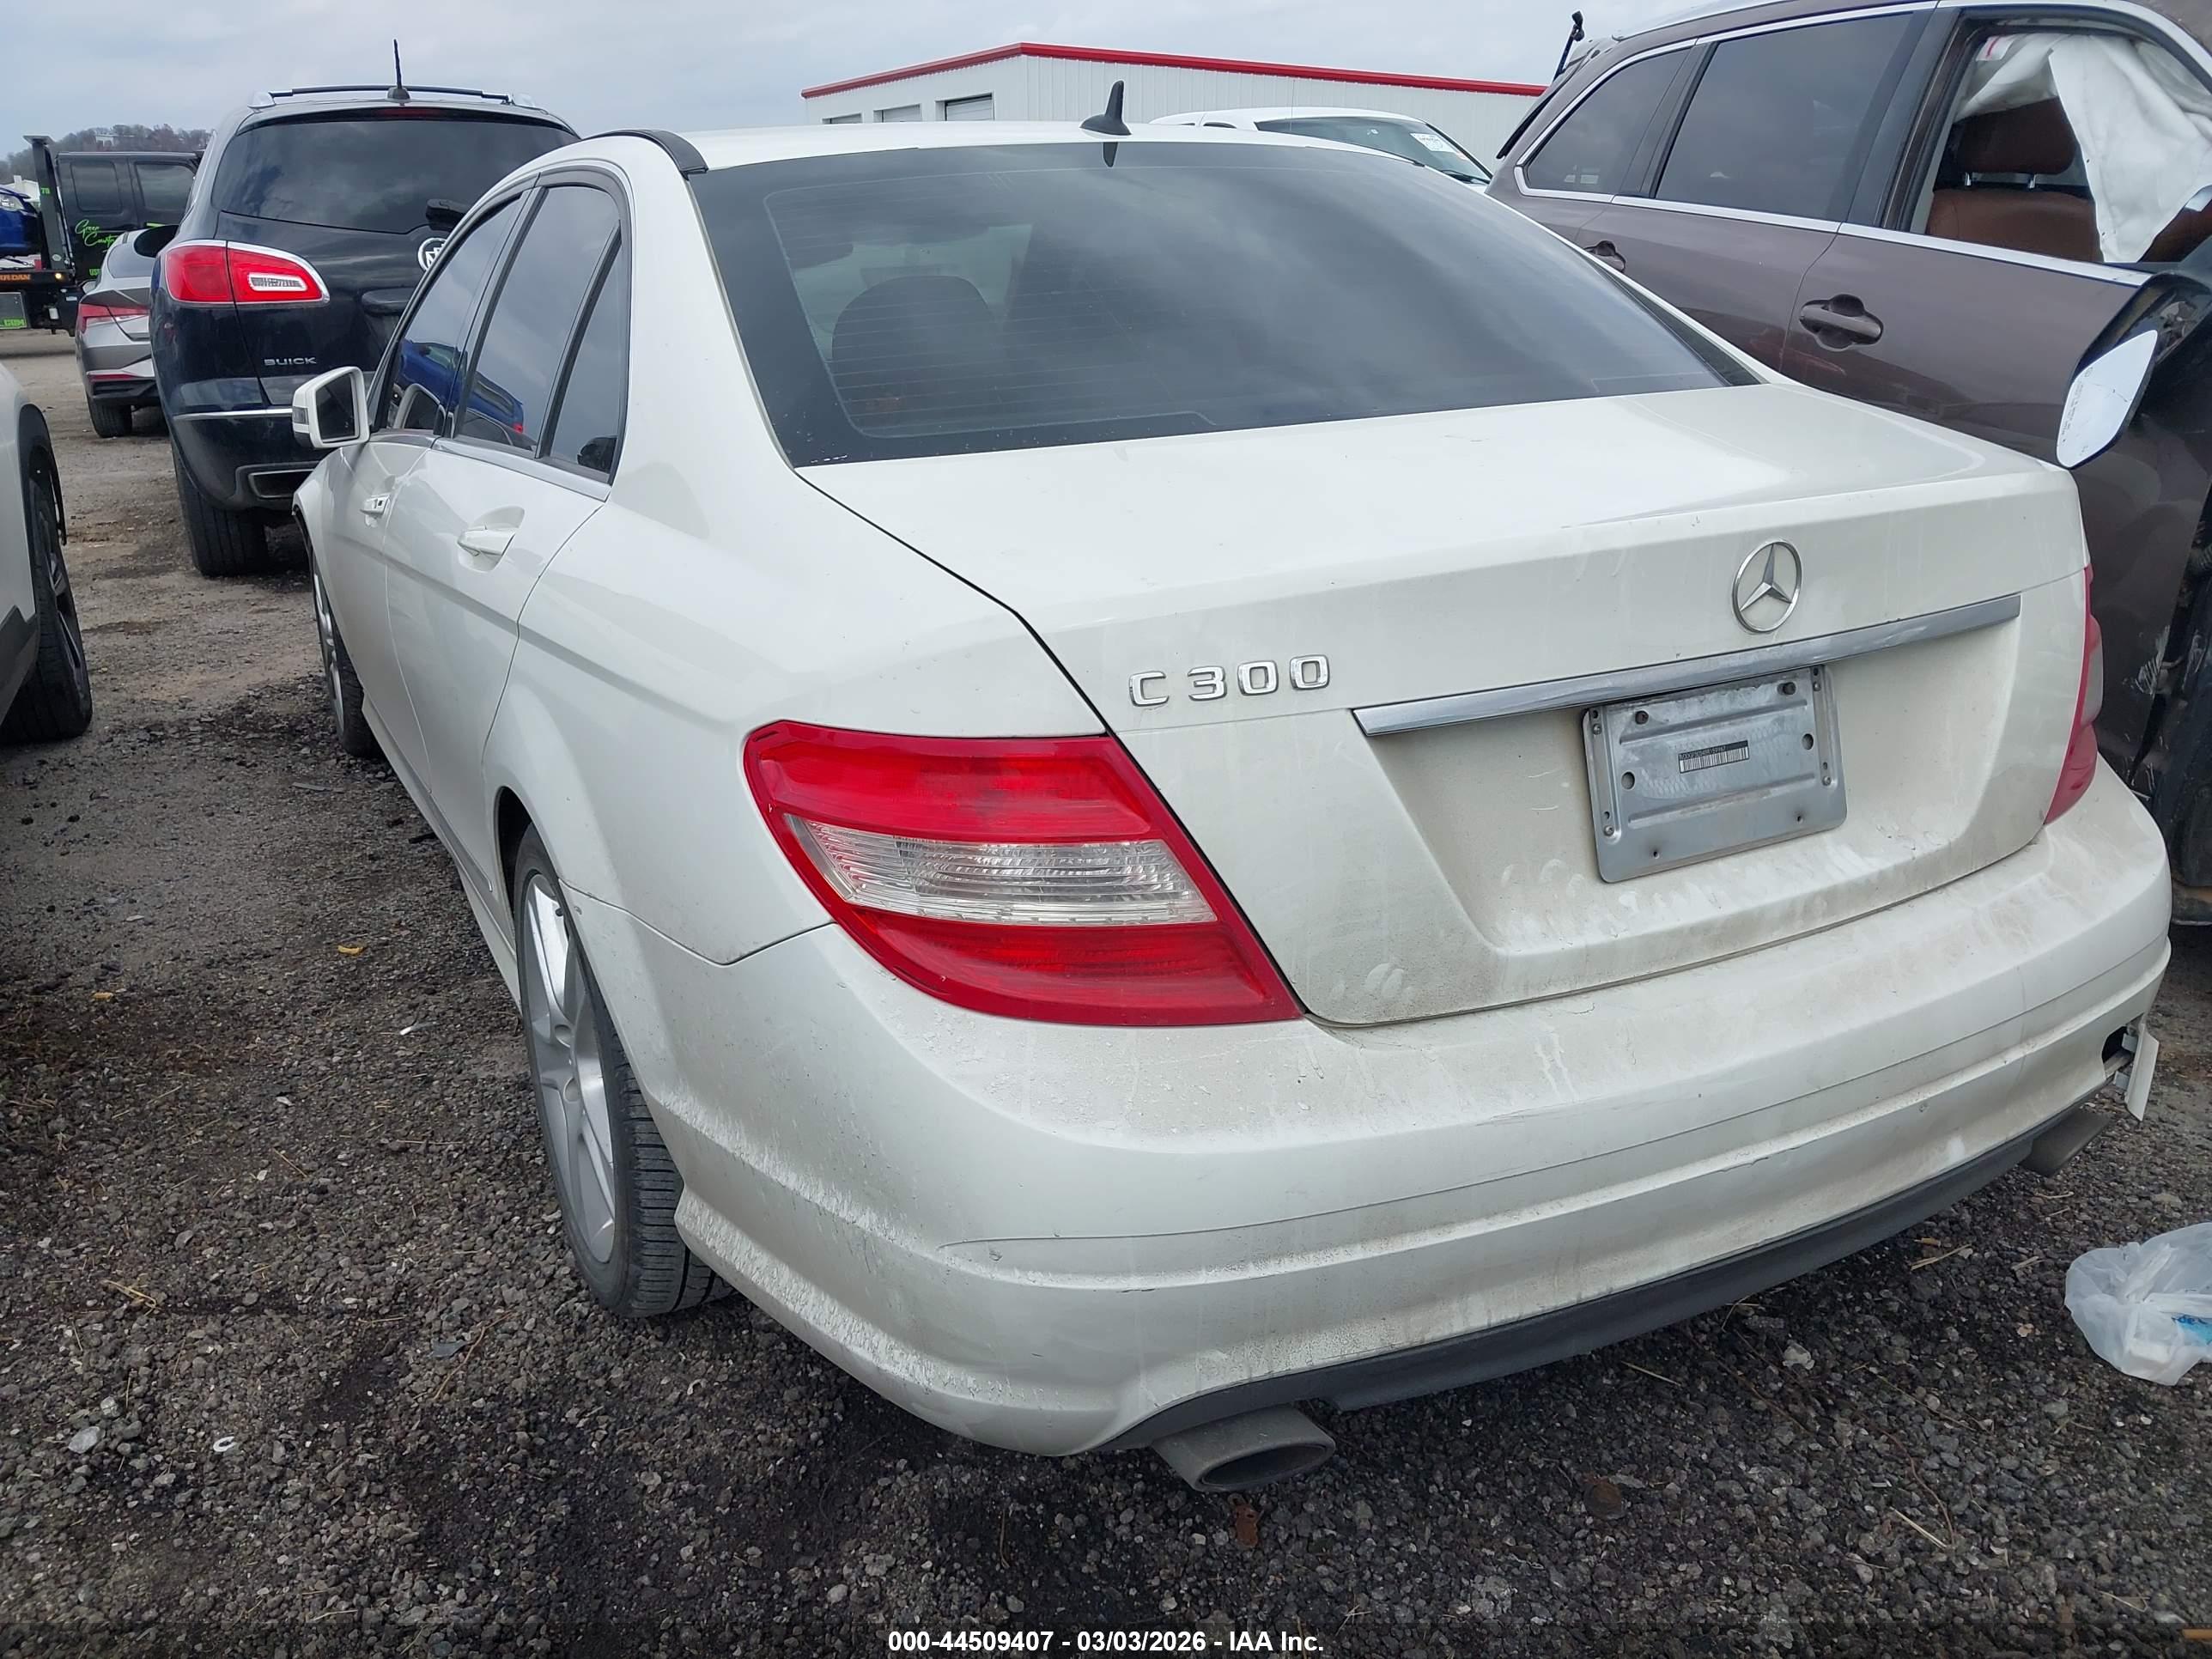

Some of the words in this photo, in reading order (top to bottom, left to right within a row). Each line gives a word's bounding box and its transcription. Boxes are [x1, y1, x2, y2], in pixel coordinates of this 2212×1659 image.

[75, 219, 100, 240] Green
[264, 356, 317, 366] BUICK
[1128, 670, 1170, 708] C
[1188, 654, 1330, 702] 300
